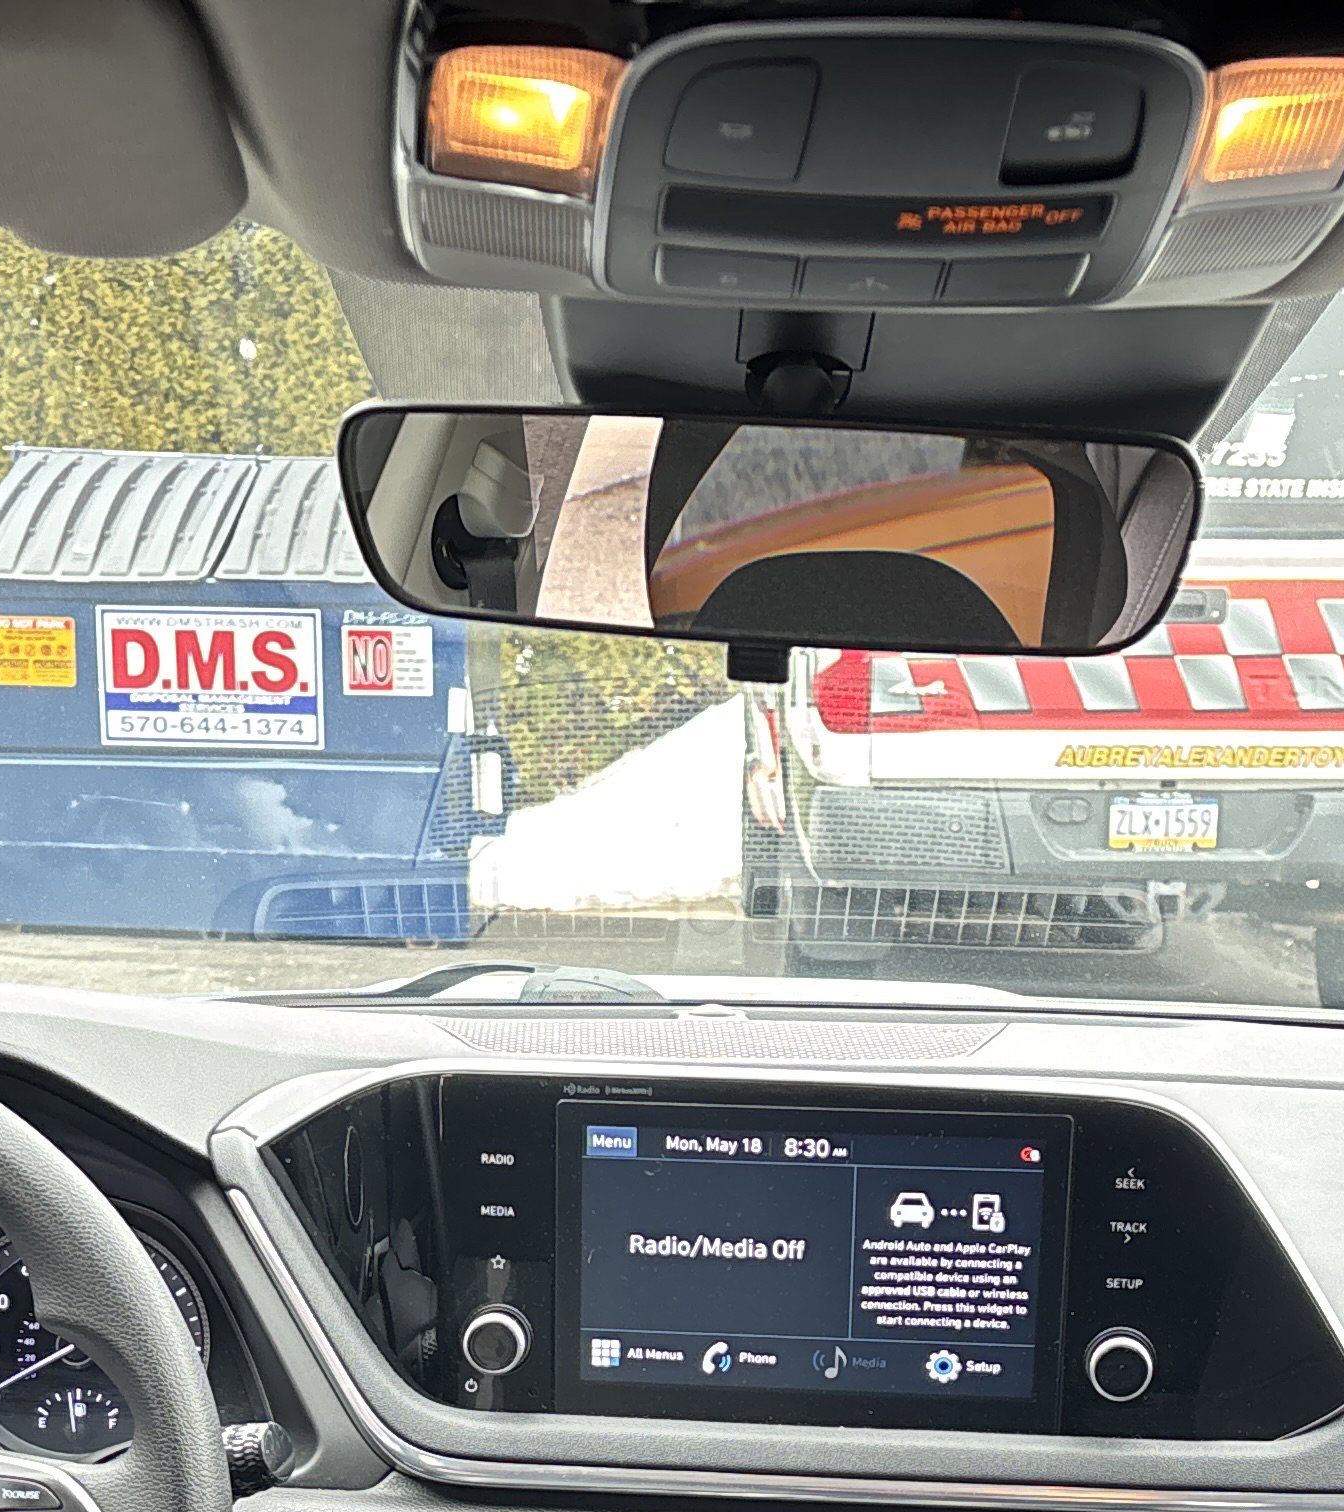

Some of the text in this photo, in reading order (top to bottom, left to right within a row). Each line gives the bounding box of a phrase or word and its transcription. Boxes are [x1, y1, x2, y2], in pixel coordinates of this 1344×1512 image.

[927, 204, 1045, 220] PASSENGER
[1046, 208, 1084, 225] OFF
[943, 219, 1022, 234] AIR BAG
[1204, 477, 1243, 498] REE
[1244, 478, 1306, 498] STATE
[111, 628, 309, 693] D.M.S.
[348, 634, 393, 687] NO
[120, 715, 305, 736] 570-644-1374
[592, 1134, 632, 1149] Menu
[665, 1135, 762, 1156] Mon, May 18
[783, 1138, 848, 1158] 8:30 AM
[480, 1152, 515, 1166] RADIO
[1115, 1178, 1146, 1190] SEEK
[480, 1204, 515, 1217] MEDIA
[1109, 1221, 1147, 1233] TRACK
[629, 1233, 806, 1261] Radio/Media Off
[862, 1239, 1032, 1257] Android Auto and Apple CarPlay
[869, 1256, 1023, 1271] are available by connecting a
[873, 1271, 1017, 1286] compatible device using an
[1105, 1277, 1144, 1290] SETUP
[860, 1285, 1029, 1300] approved USB cable or wireless
[860, 1300, 1027, 1316] connection. Press this widget to
[28, 1321, 40, 1331] 60
[876, 1315, 1011, 1330] start connecting a device.
[23, 1337, 35, 1346] 40
[24, 1353, 36, 1363] 20
[627, 1347, 684, 1362] All Menus
[739, 1351, 777, 1366] Phone
[852, 1355, 887, 1369] Media
[966, 1359, 1002, 1375] Setup
[38, 1417, 47, 1429] E
[108, 1417, 117, 1430] F
